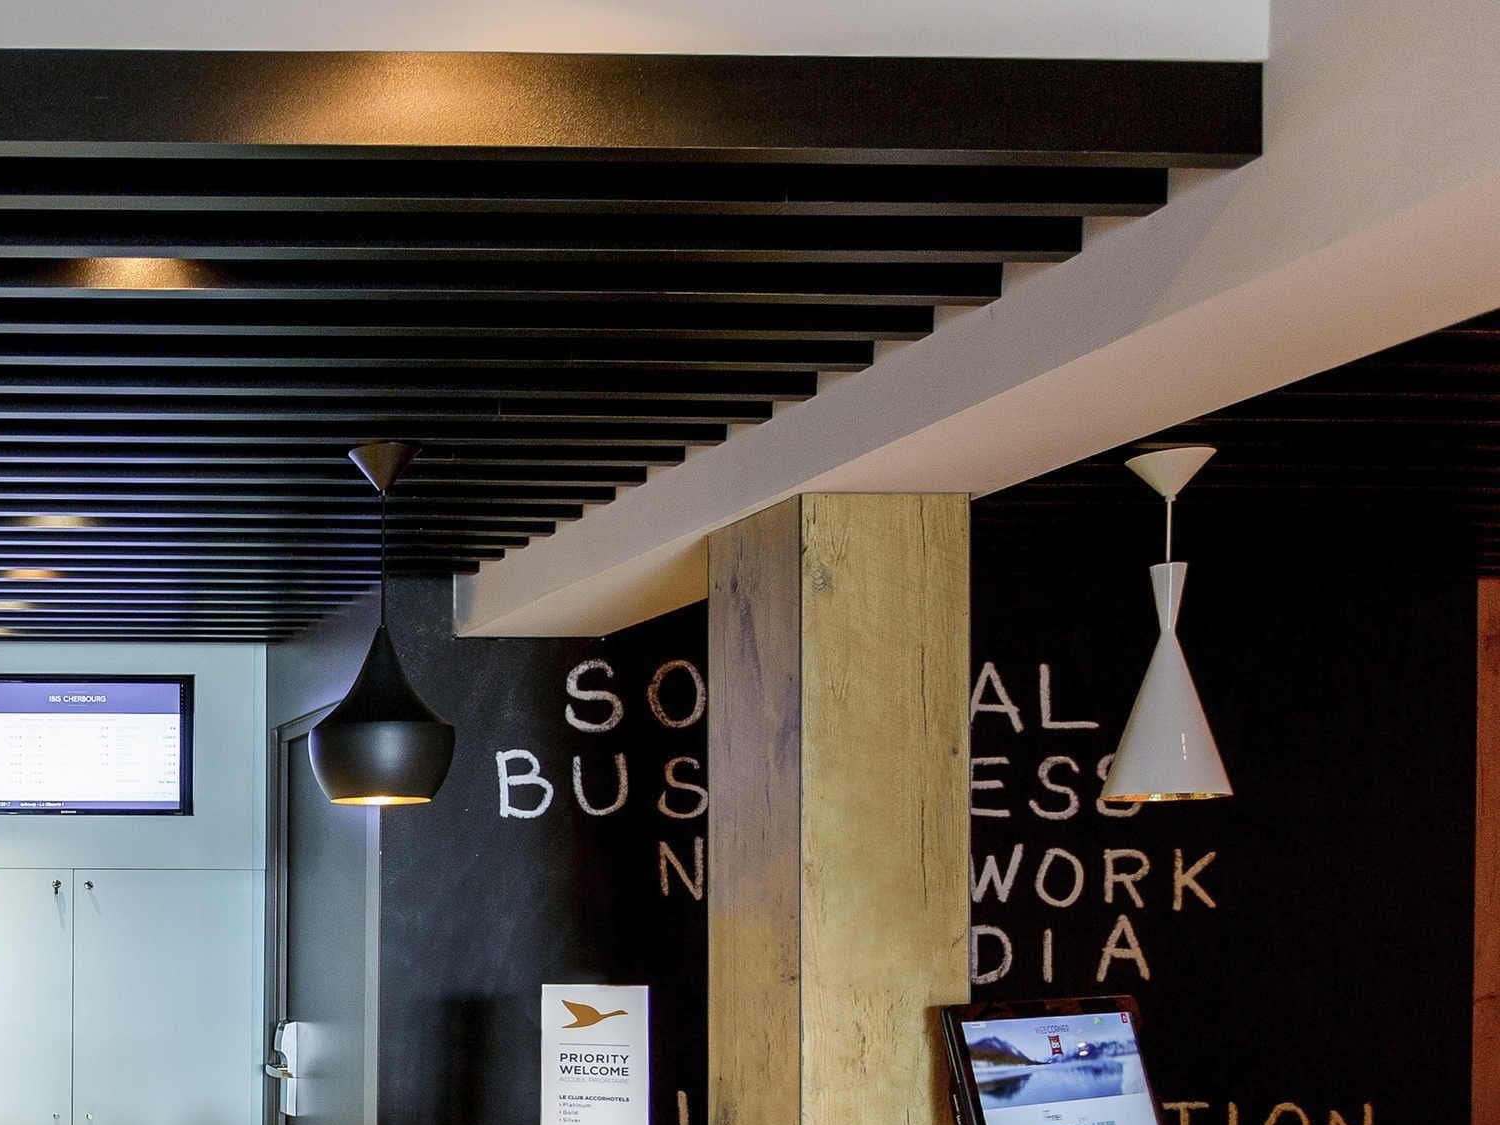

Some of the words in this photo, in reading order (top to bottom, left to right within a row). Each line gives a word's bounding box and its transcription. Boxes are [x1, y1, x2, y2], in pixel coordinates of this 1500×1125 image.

[49, 695, 62, 703] IBIS
[63, 695, 107, 703] CHERBOURG
[559, 1053, 629, 1064] PRIORITY
[559, 1065, 629, 1076] WELCOME
